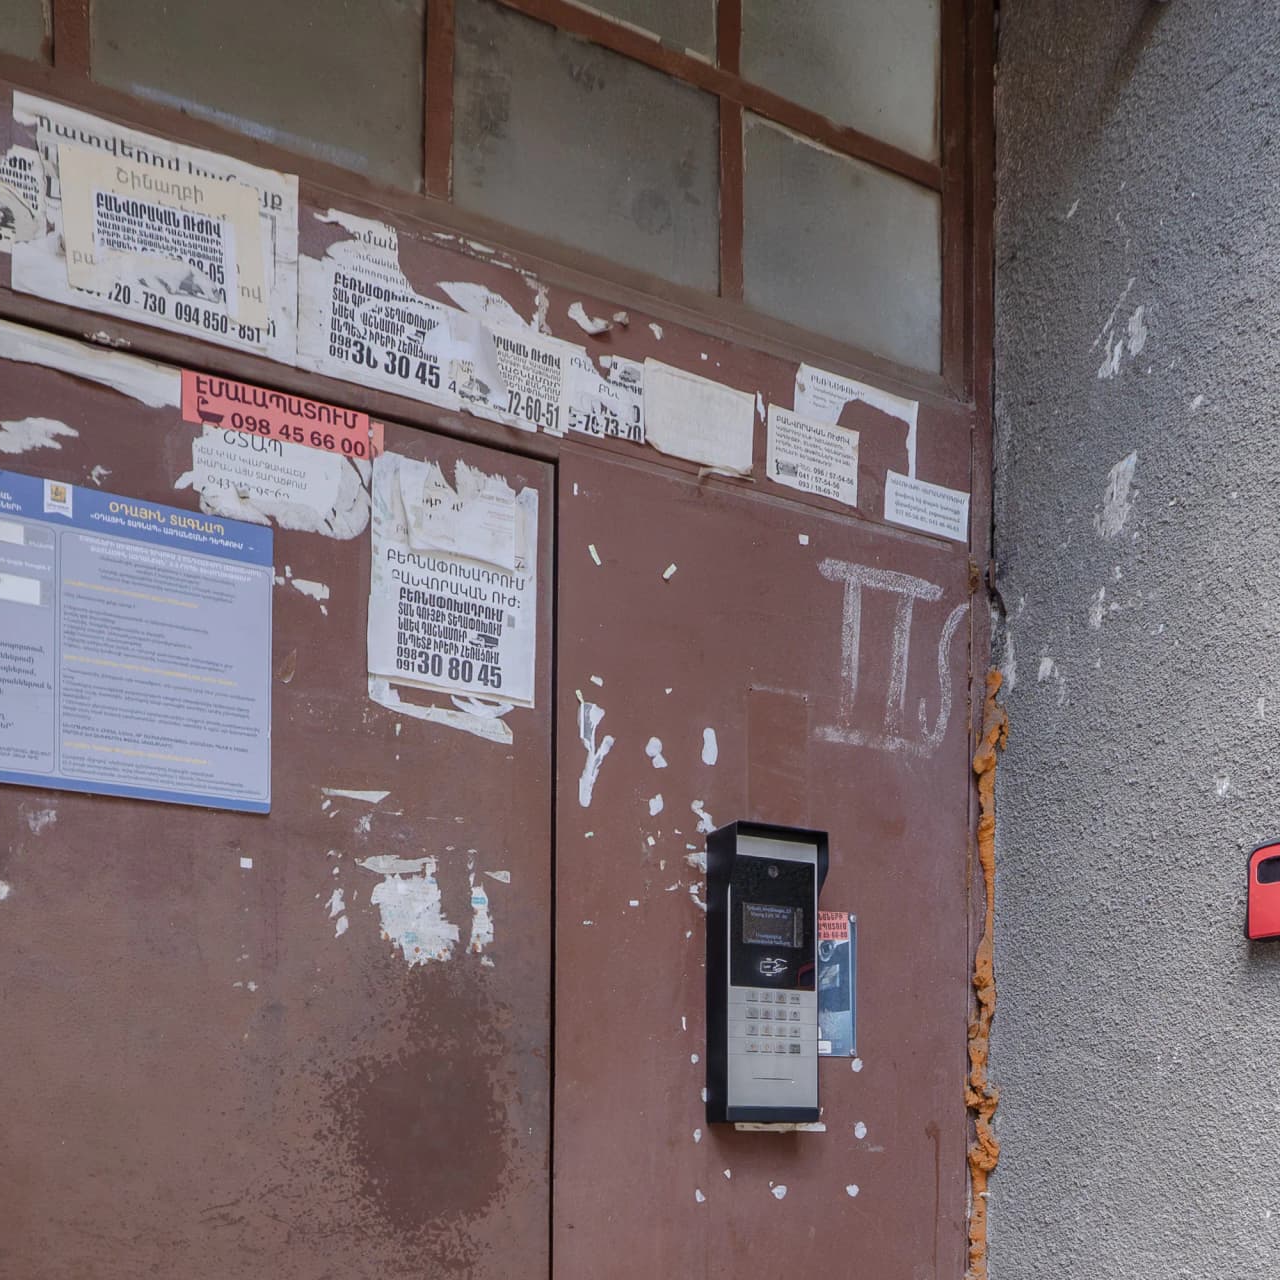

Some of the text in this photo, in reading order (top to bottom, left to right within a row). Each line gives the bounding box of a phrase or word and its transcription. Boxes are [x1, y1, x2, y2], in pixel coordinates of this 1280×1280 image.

[96, 191, 222, 239] ԲԱՆՎՈՐԱԿԱՆ ՈՒԺՈՎ
[142, 291, 166, 316] 730
[175, 302, 200, 326] 094
[203, 308, 228, 335] 850
[331, 301, 405, 338] ՆԱԵՎ ԱՇՆԱՄՈՒՐ
[329, 344, 349, 361] 091
[330, 331, 352, 349] 098
[415, 361, 440, 389] 45
[531, 347, 561, 370] ՈՒԺՈՎ
[195, 375, 359, 430] ԷՄԱԼԱՊԱՏՈՒՄ
[223, 428, 283, 457] ՇՏԱՊ
[231, 412, 366, 457] 098 45 66 00
[109, 500, 225, 537] ՕԴԱՅԻՆ ՏԱԳՆԱՊ
[387, 548, 526, 592] ԲԵՌՆԱՓՈԽԱԴՐՈՒՄ
[392, 568, 487, 601] ԲԱՆՎՈՐԱԿԱՆ
[398, 601, 502, 637] ՏԱՆ ԳՈՒՅՔԻ ՏԵՂԱՓՈԽՈՒՄ
[399, 586, 504, 623] ԲԵՌՆԱՓՈԽԱԴՐՈՒՄ
[397, 631, 432, 650] ԱՆՊԵՏՔ
[433, 639, 459, 656] ԻՐԵՐԻ
[398, 616, 468, 644] ՆԱԵՎ ԴԱՇՆԱՄՈՒՐ
[396, 658, 416, 672] 091
[396, 647, 502, 690] 098 30 80 45
